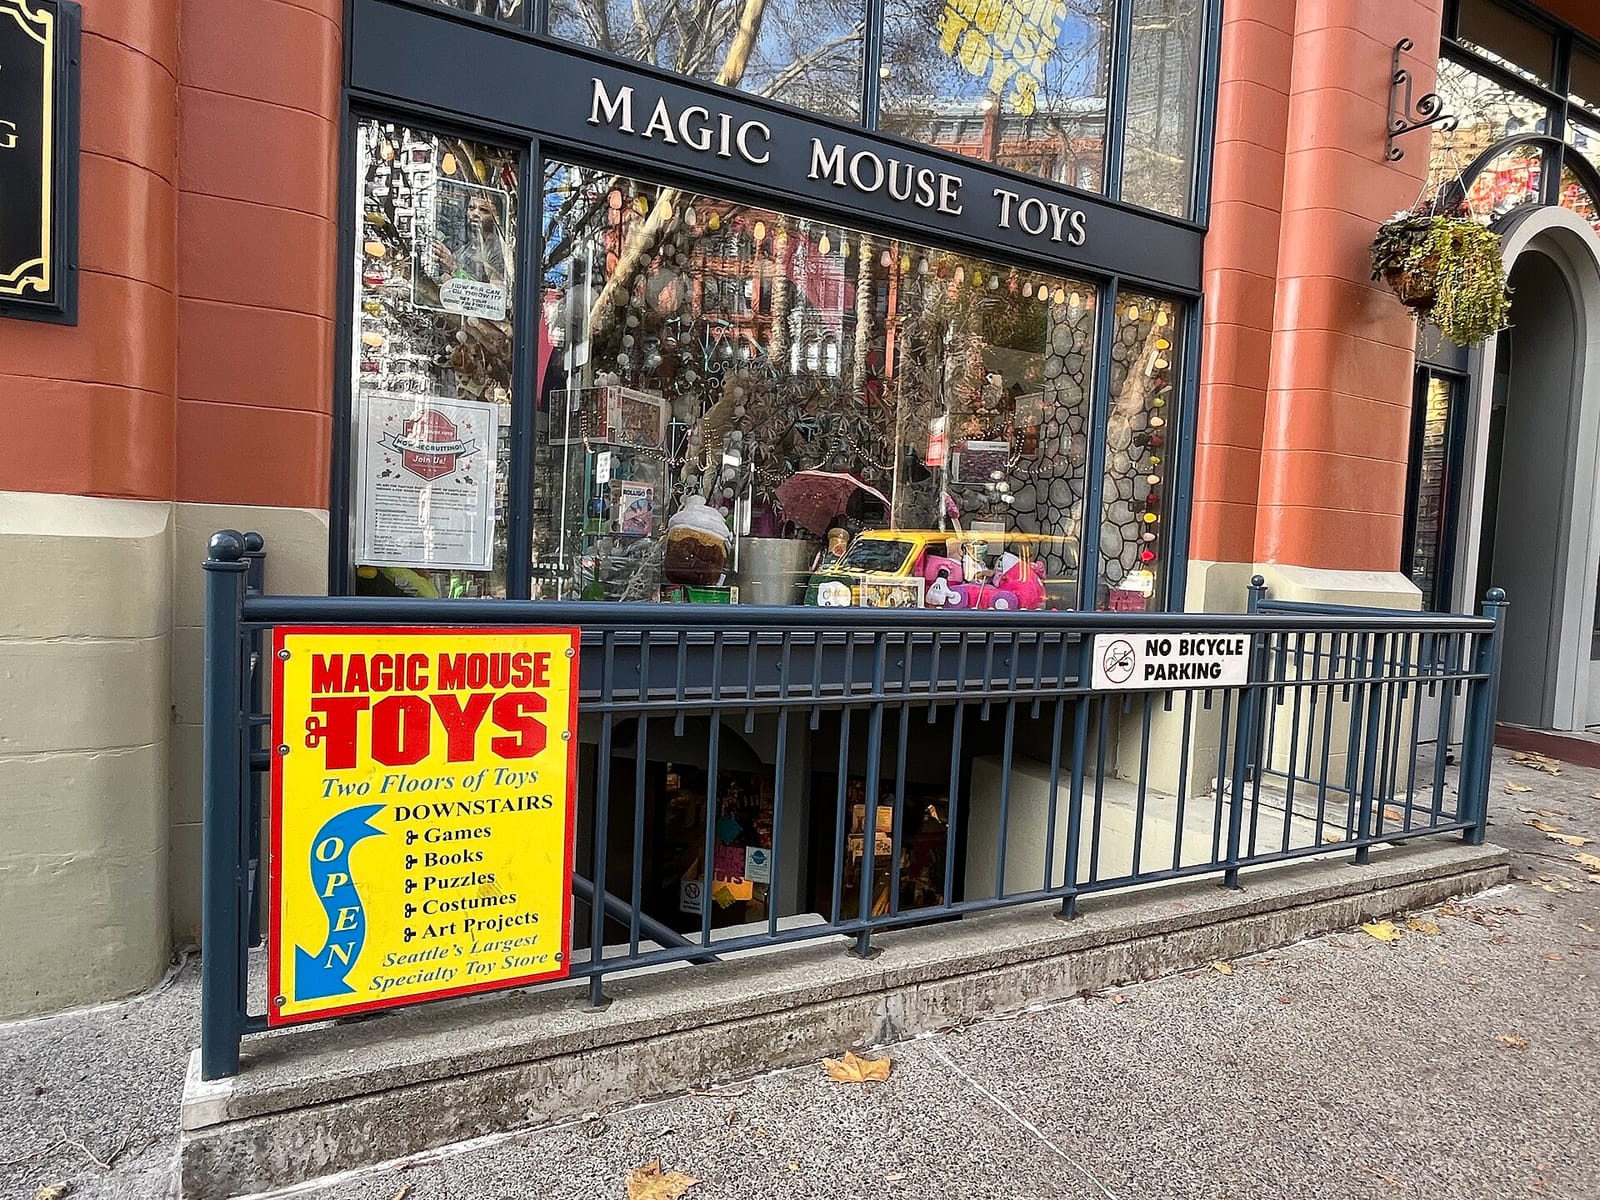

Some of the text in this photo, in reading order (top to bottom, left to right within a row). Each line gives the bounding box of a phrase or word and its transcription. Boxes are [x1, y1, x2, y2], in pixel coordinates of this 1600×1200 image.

[587, 77, 1087, 247] MAGIC MOUSE TOYS
[395, 438, 415, 448] NOW
[412, 455, 447, 465] Join Us!
[1145, 638, 1244, 657] NO BICYCLE
[311, 652, 550, 693] MAGIC MOUSE
[1144, 662, 1222, 682] PARKING
[308, 692, 547, 770] TOYS
[322, 768, 539, 798] Two Floors of Toys
[394, 794, 553, 822] DOWNSTAIRS
[424, 825, 492, 844] Games
[424, 849, 484, 868] Books
[423, 872, 496, 892] Puzzles
[316, 837, 360, 969] OPEN
[422, 892, 517, 916] Costumes
[421, 911, 540, 941] Art Projects
[470, 933, 539, 956] Largest
[369, 951, 549, 993] Specialty Toy Store
